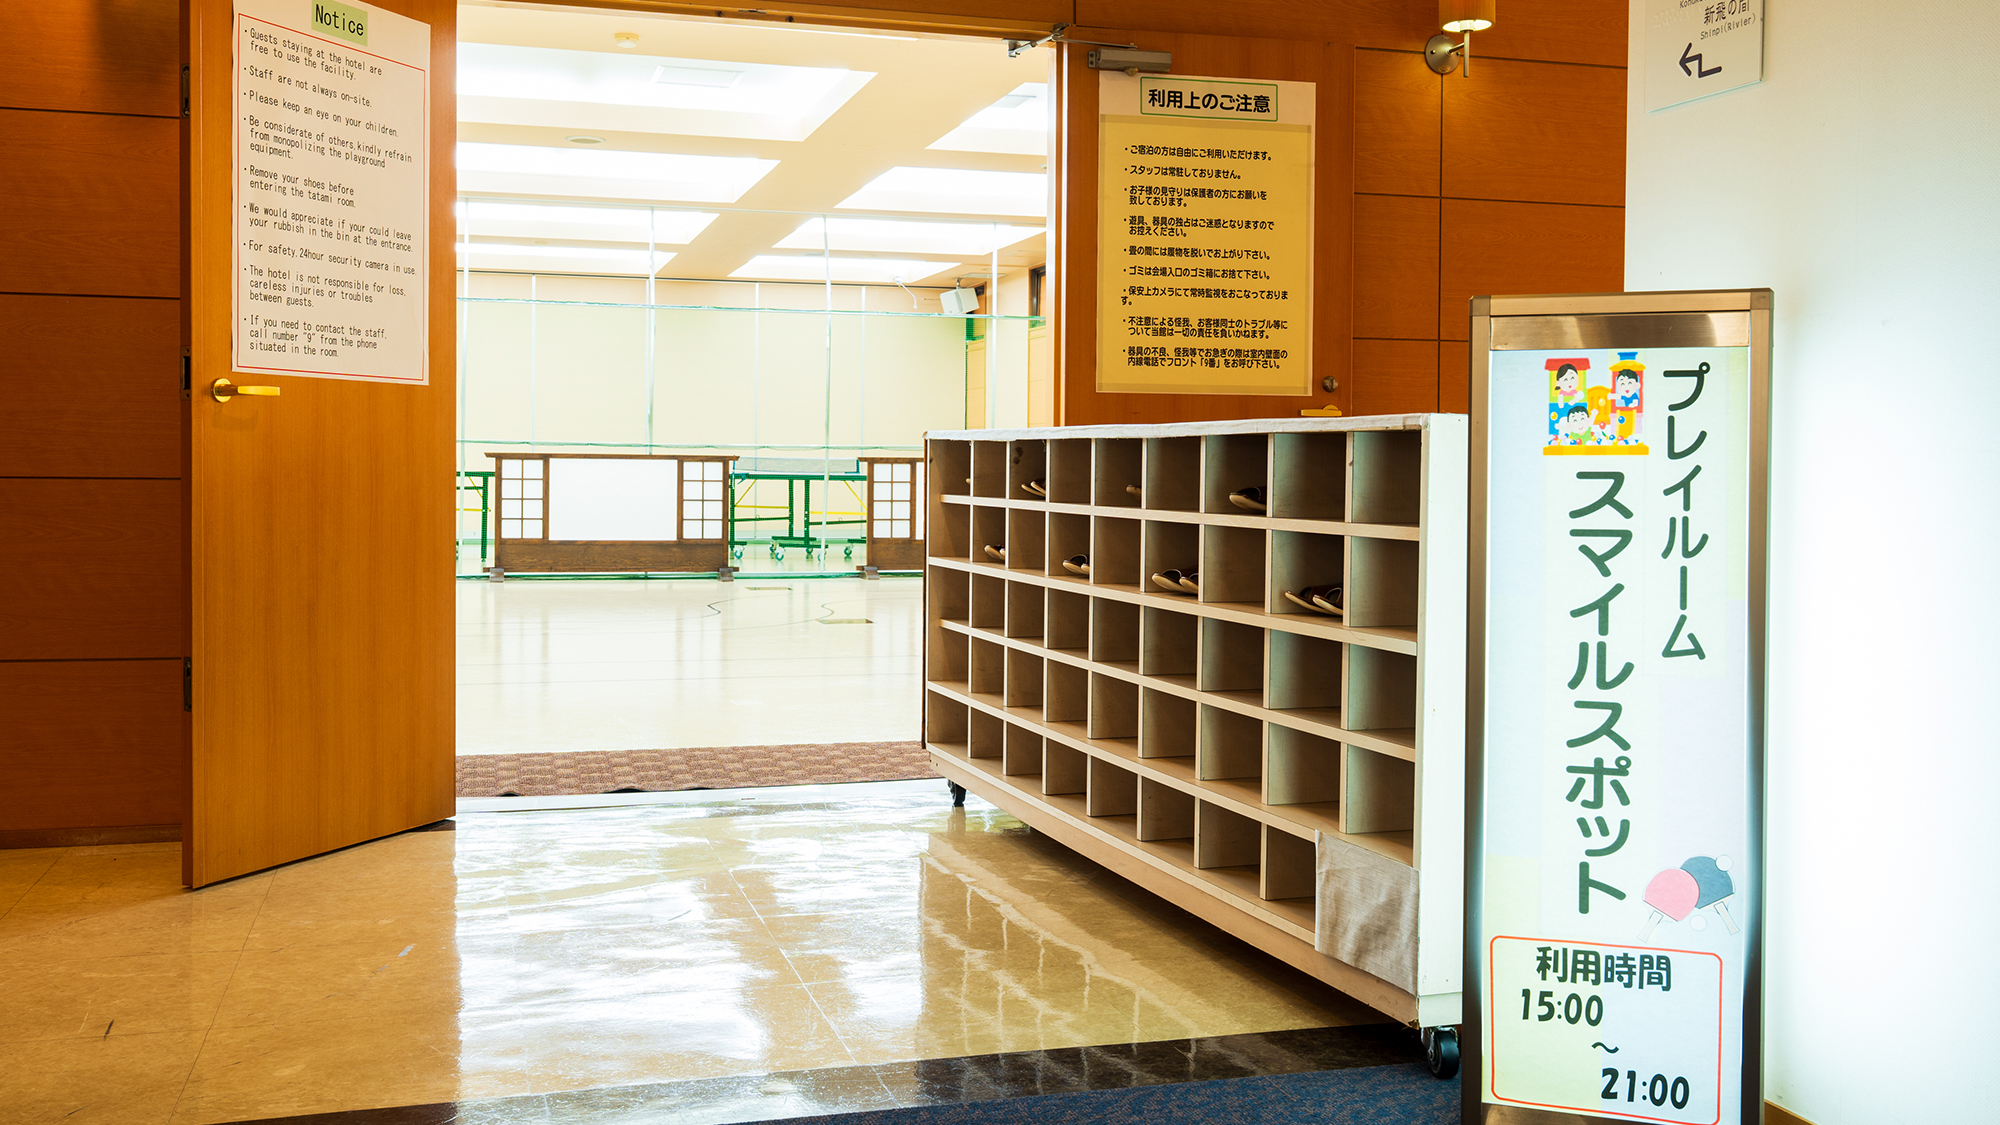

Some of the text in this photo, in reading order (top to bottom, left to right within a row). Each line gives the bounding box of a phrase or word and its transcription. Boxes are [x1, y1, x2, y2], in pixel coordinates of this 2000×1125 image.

[315, 4, 364, 36] Notice
[250, 28, 382, 76] Guests staying at the hotel are
[250, 41, 356, 81] free to use the facility.
[249, 65, 372, 108] Staff are not always on-site.
[1148, 89, 1271, 114] 利用上のご注意
[250, 90, 399, 138] Please keep an eye on your children.
[249, 115, 260, 127] Be
[264, 121, 313, 140] considerate
[316, 132, 325, 142] of
[385, 150, 412, 163] refrain
[250, 128, 386, 168] from monopolizing the playground
[250, 142, 294, 159] equipment.
[250, 164, 354, 196] Remove your shoes before
[250, 180, 356, 208] entering the tatami room.
[1129, 195, 1187, 208] 致しております。
[249, 202, 412, 241] We would appreciate if your could leave
[249, 217, 413, 253] your rubbish in the bin at the entrance.
[1129, 226, 1187, 237] お控えください。
[249, 240, 263, 252] For
[328, 254, 362, 268] security
[365, 260, 389, 271] camera
[393, 263, 400, 273] in
[404, 266, 417, 276] use.
[250, 264, 264, 277] The
[268, 268, 291, 280] hotel
[296, 271, 304, 282] is
[308, 275, 320, 284] not
[324, 278, 369, 291] responsible
[373, 282, 384, 293] for
[250, 280, 373, 303] careless injuries or troubles
[250, 290, 314, 308] between guests.
[1121, 296, 1132, 306] す。
[250, 315, 259, 325] If
[263, 318, 277, 328] you
[281, 320, 299, 330] need
[303, 321, 312, 331] to
[315, 324, 345, 335] contact
[349, 326, 362, 336] the
[250, 328, 268, 339] call
[272, 331, 299, 341] number
[320, 334, 337, 345] from
[341, 337, 354, 347] the
[357, 339, 378, 349] phone
[250, 340, 339, 357] situated in the room.
[1661, 361, 1708, 662] プレイルーム
[1566, 470, 1634, 916] スマイルスポット
[1536, 946, 1672, 992] 利用時間
[1521, 988, 1604, 1027] 15:00
[1601, 1068, 1690, 1110] 21:00
